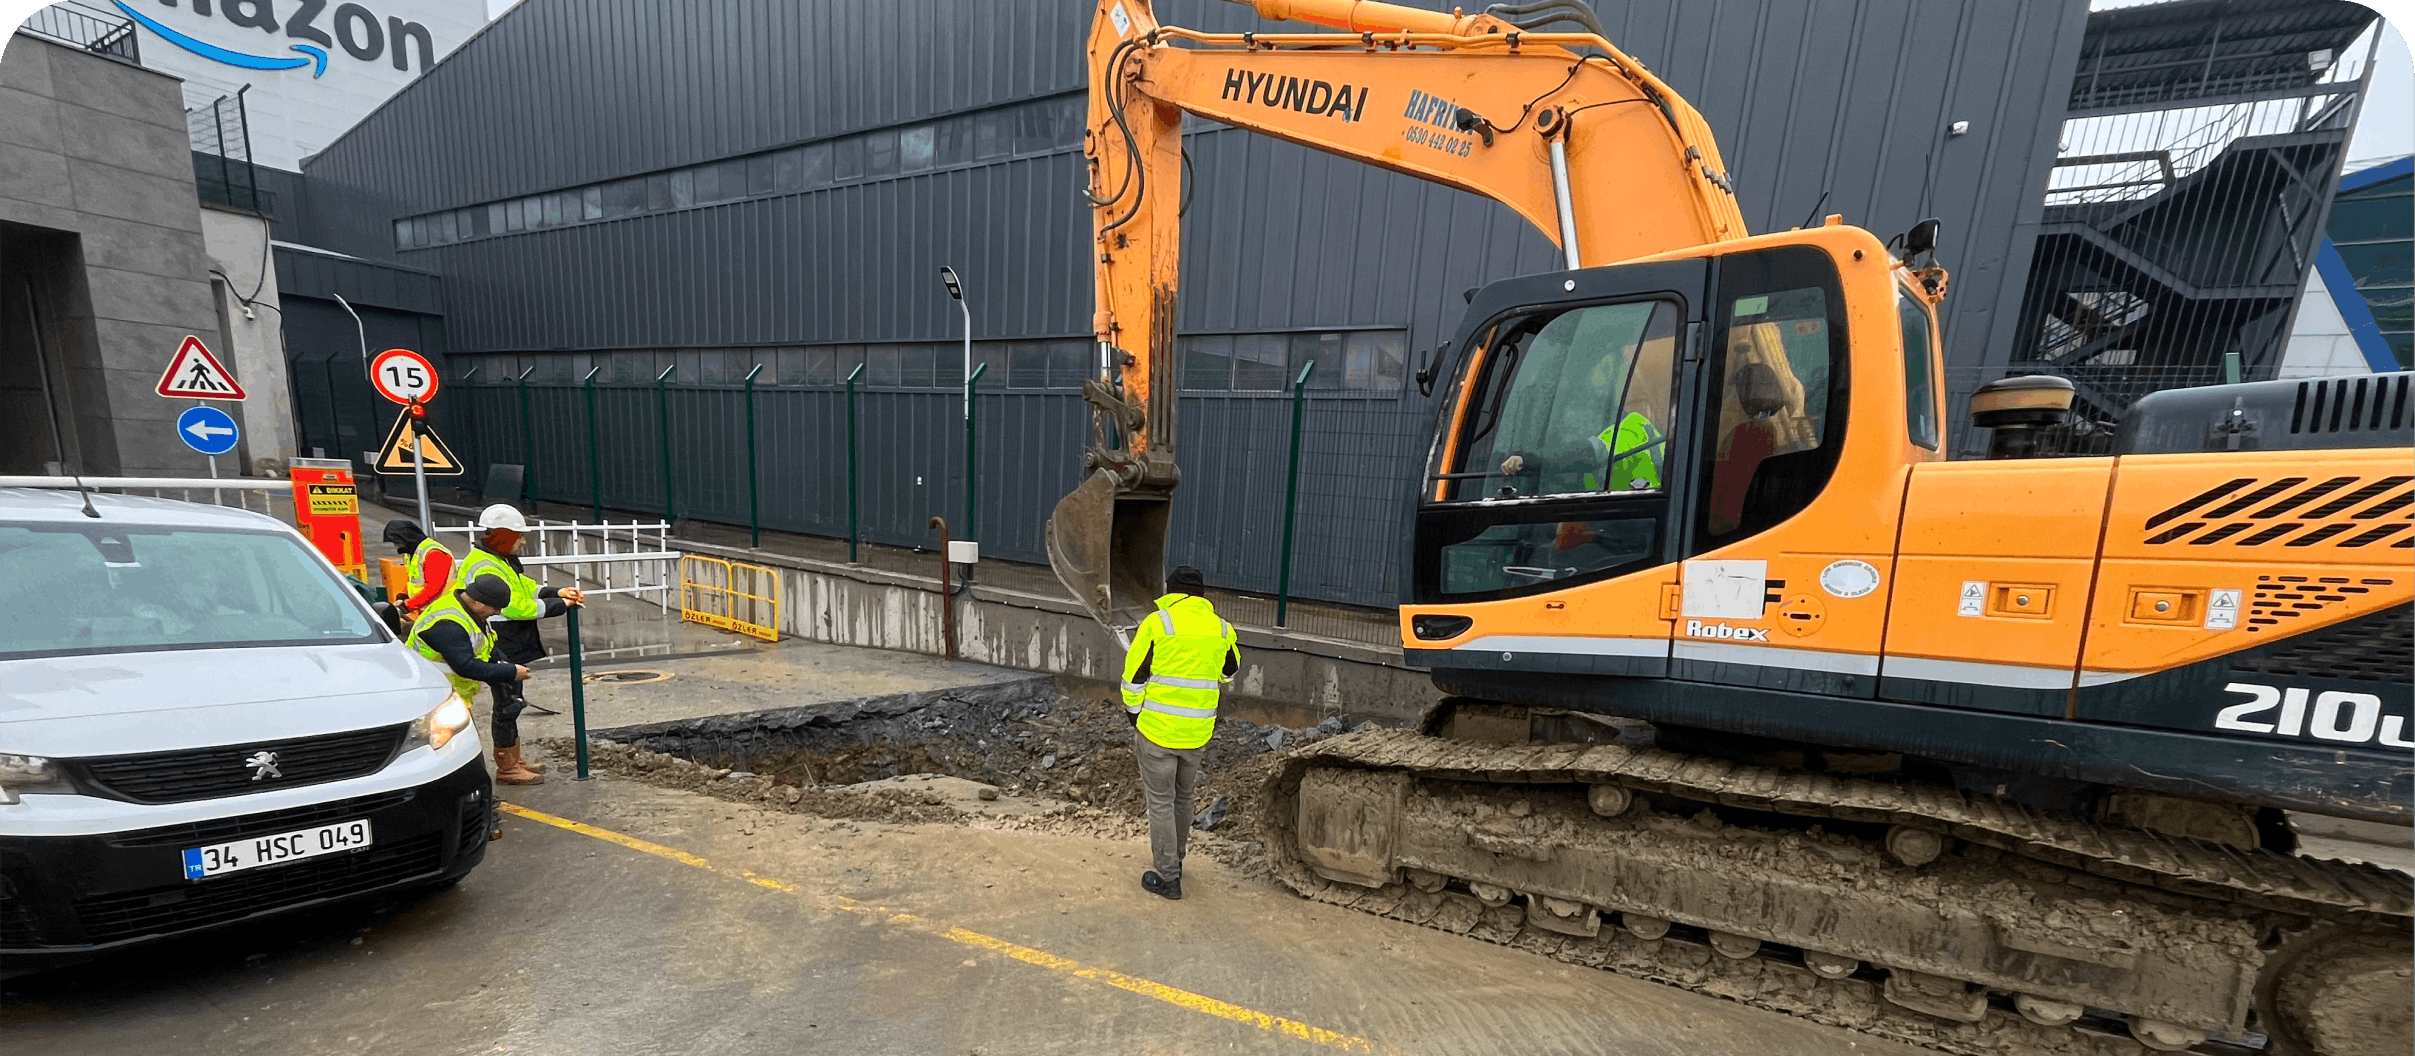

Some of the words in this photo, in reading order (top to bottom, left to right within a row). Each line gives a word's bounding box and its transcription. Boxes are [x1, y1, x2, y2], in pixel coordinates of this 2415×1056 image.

[1221, 67, 1369, 122] HYUNDAI
[1406, 125, 1428, 145] 0530
[1429, 132, 1446, 150] 442
[1446, 136, 1459, 154] 02
[386, 366, 424, 388] 15
[1686, 619, 1772, 642] Robex
[204, 846, 239, 871] 34
[256, 834, 305, 862] HSC
[319, 823, 364, 850] 049
[189, 864, 203, 872] TR
